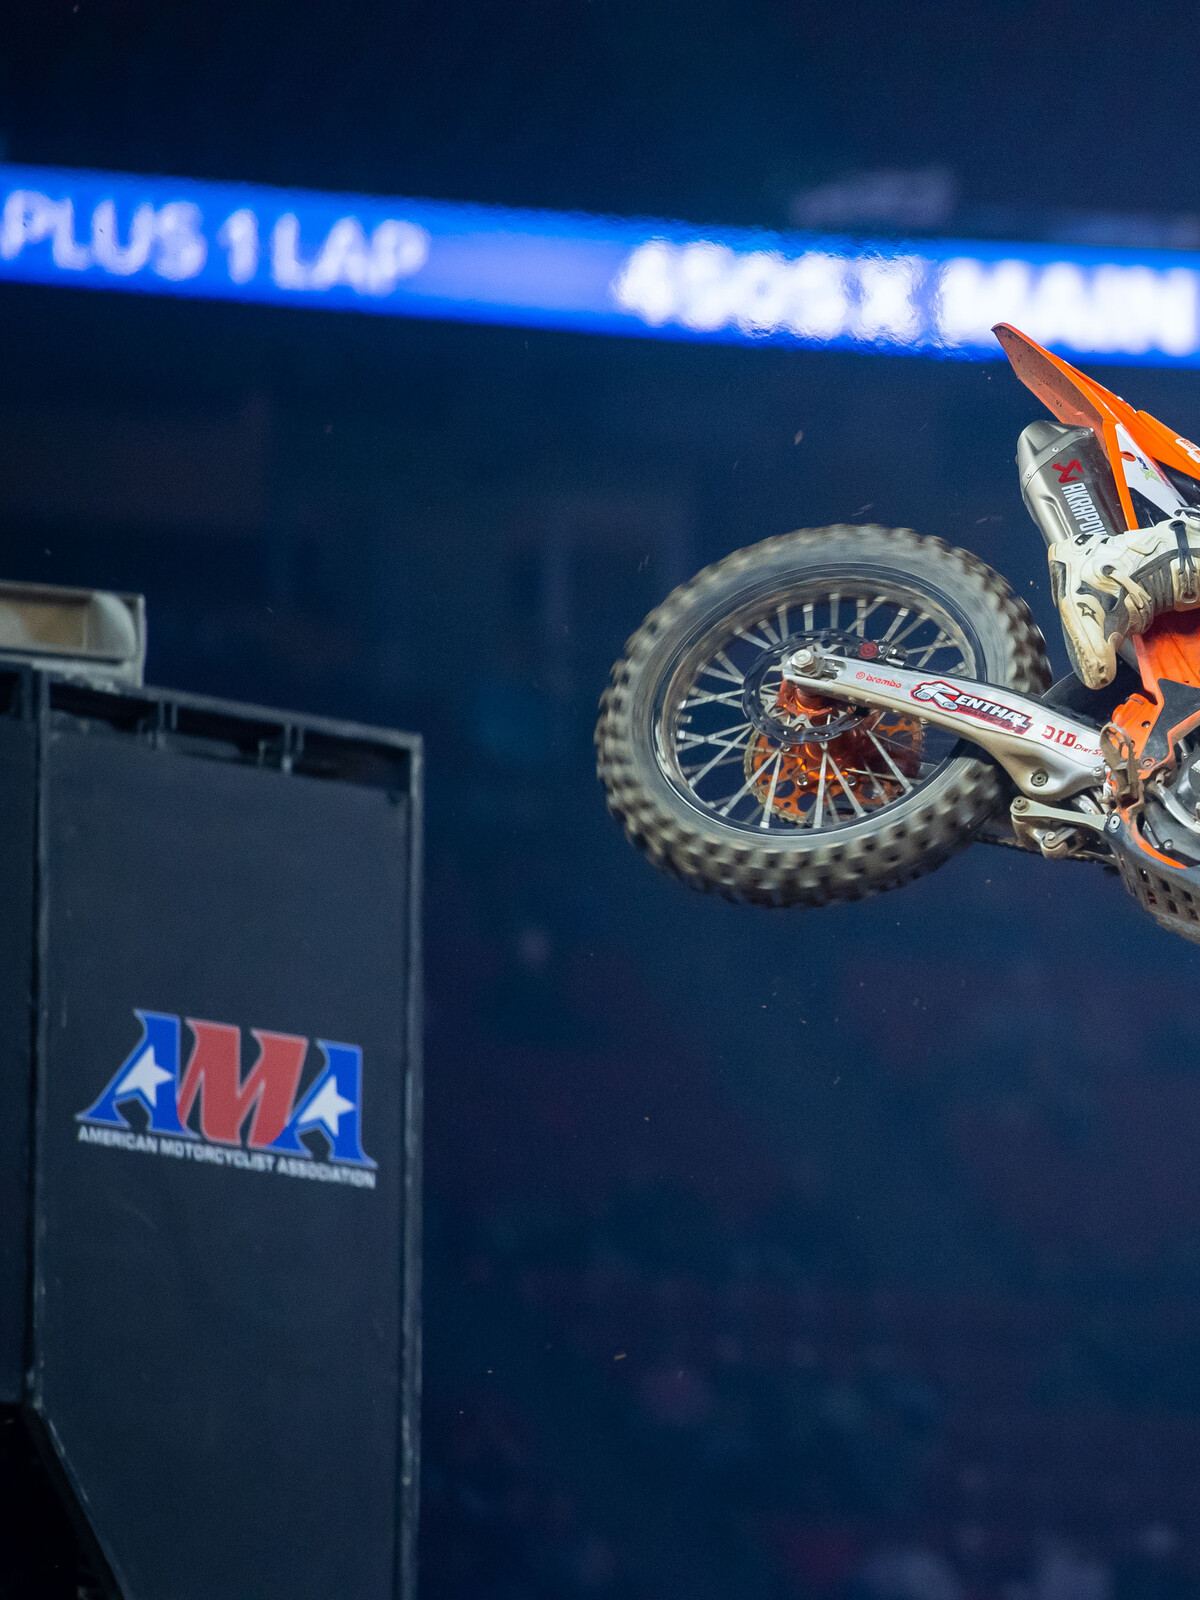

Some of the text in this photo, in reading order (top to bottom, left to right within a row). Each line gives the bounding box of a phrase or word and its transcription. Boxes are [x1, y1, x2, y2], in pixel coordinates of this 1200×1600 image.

[0, 188, 429, 297] PLUS 1 LAP
[936, 257, 1199, 357] MAIN
[1062, 482, 1109, 536] AKRAPOV
[865, 673, 902, 689] brembo
[911, 681, 1030, 729] RENTHAL
[75, 1008, 378, 1170] AMA
[78, 1126, 377, 1189] AMERICAN MOTORCYCLIST ASSOCIATION
